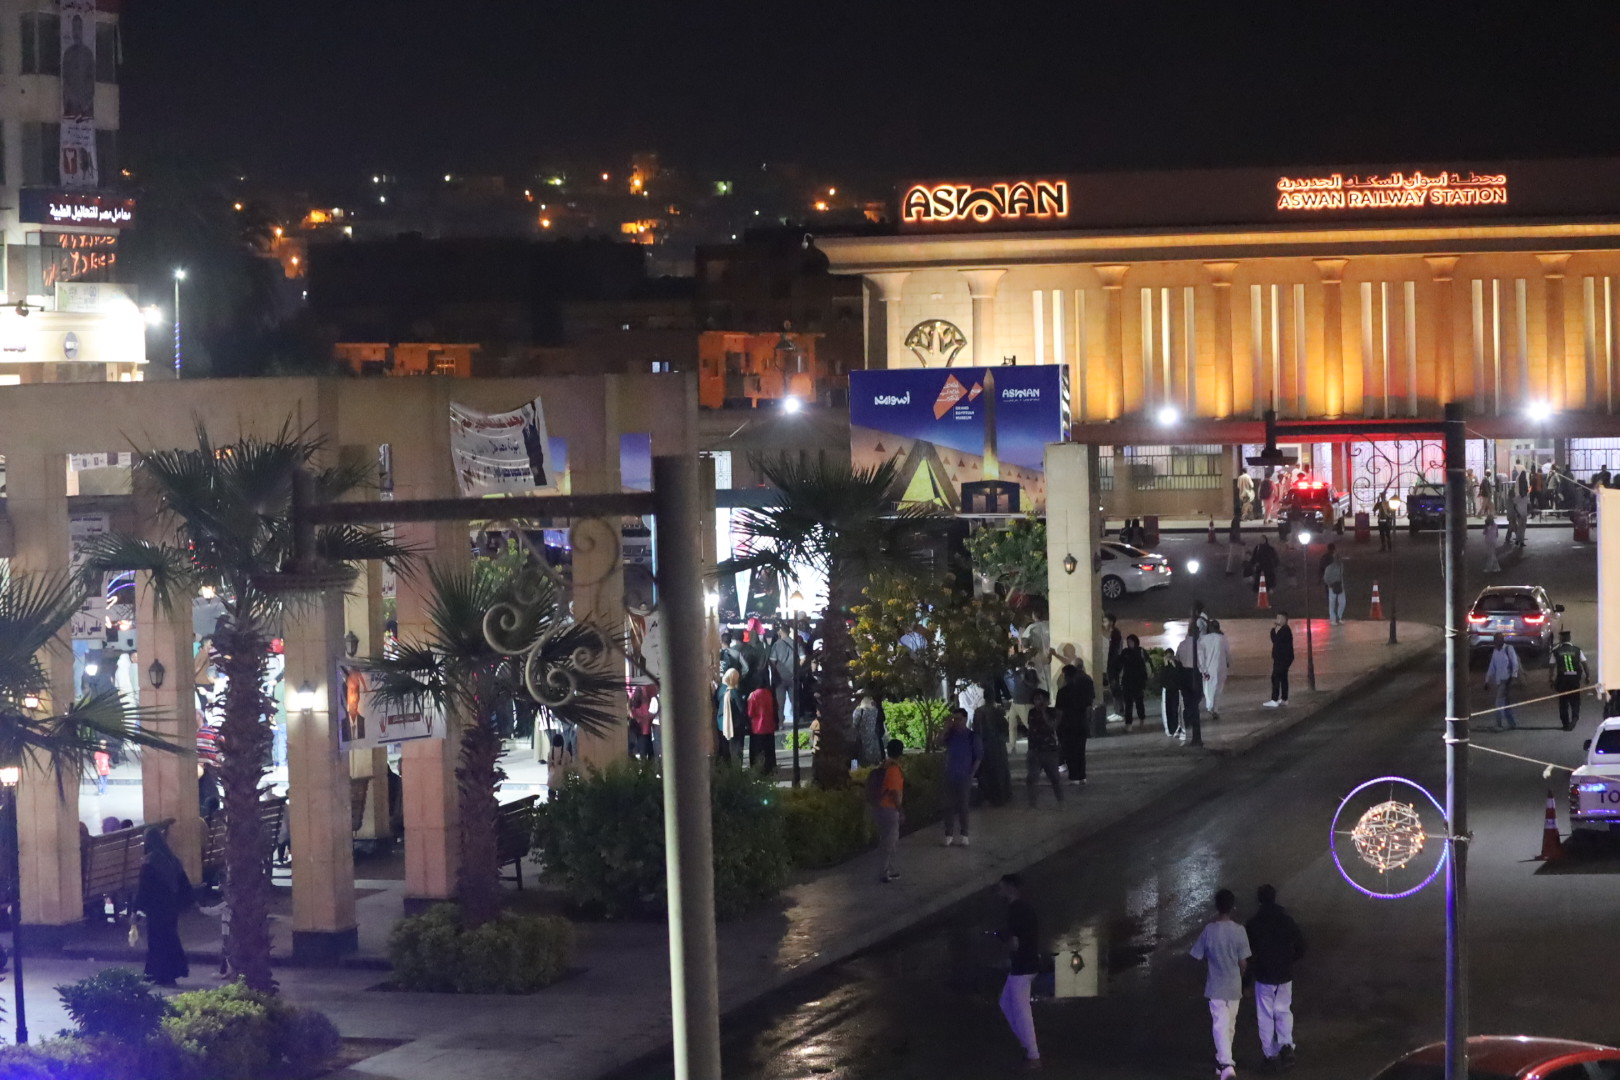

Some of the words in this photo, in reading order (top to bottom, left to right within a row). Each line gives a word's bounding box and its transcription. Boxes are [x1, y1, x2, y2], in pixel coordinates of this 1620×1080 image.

[1277, 174, 1342, 190] الحديدية
[1405, 171, 1447, 188] أسوان
[1449, 172, 1505, 185] محطة
[903, 181, 1068, 222] ASWAN
[1277, 191, 1345, 209] ASWAN
[1347, 189, 1428, 207] RAILWAY
[1430, 187, 1507, 203] STATION
[49, 203, 71, 221] الطبية
[71, 205, 98, 222] للتحاليل
[99, 210, 112, 221] مصر
[112, 207, 131, 223] معامل
[874, 391, 911, 406] أسوان
[1002, 388, 1040, 398] ASWAN
